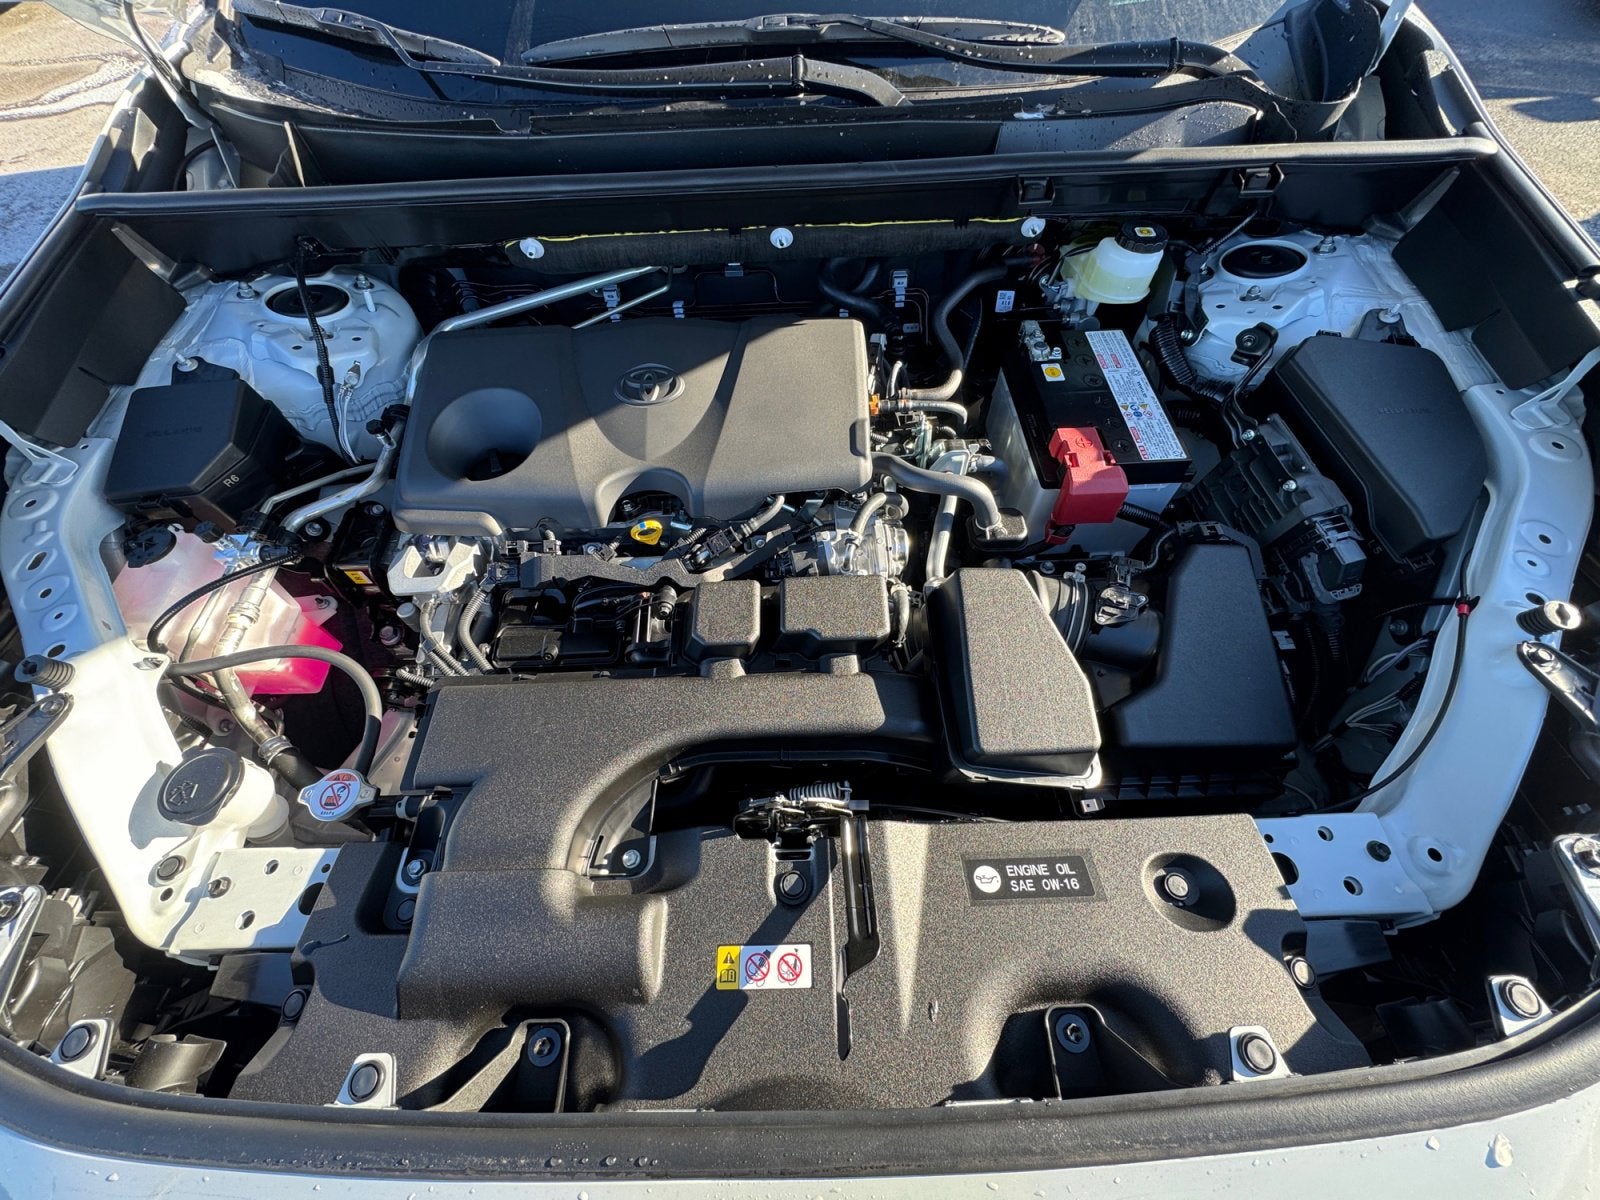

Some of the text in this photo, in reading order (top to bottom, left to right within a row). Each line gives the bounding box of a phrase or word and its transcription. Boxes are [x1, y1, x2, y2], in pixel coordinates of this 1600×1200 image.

[223, 474, 240, 487] R6
[1005, 863, 1076, 877] ENGINE OIL
[1010, 878, 1080, 892] SAE 0W-16
